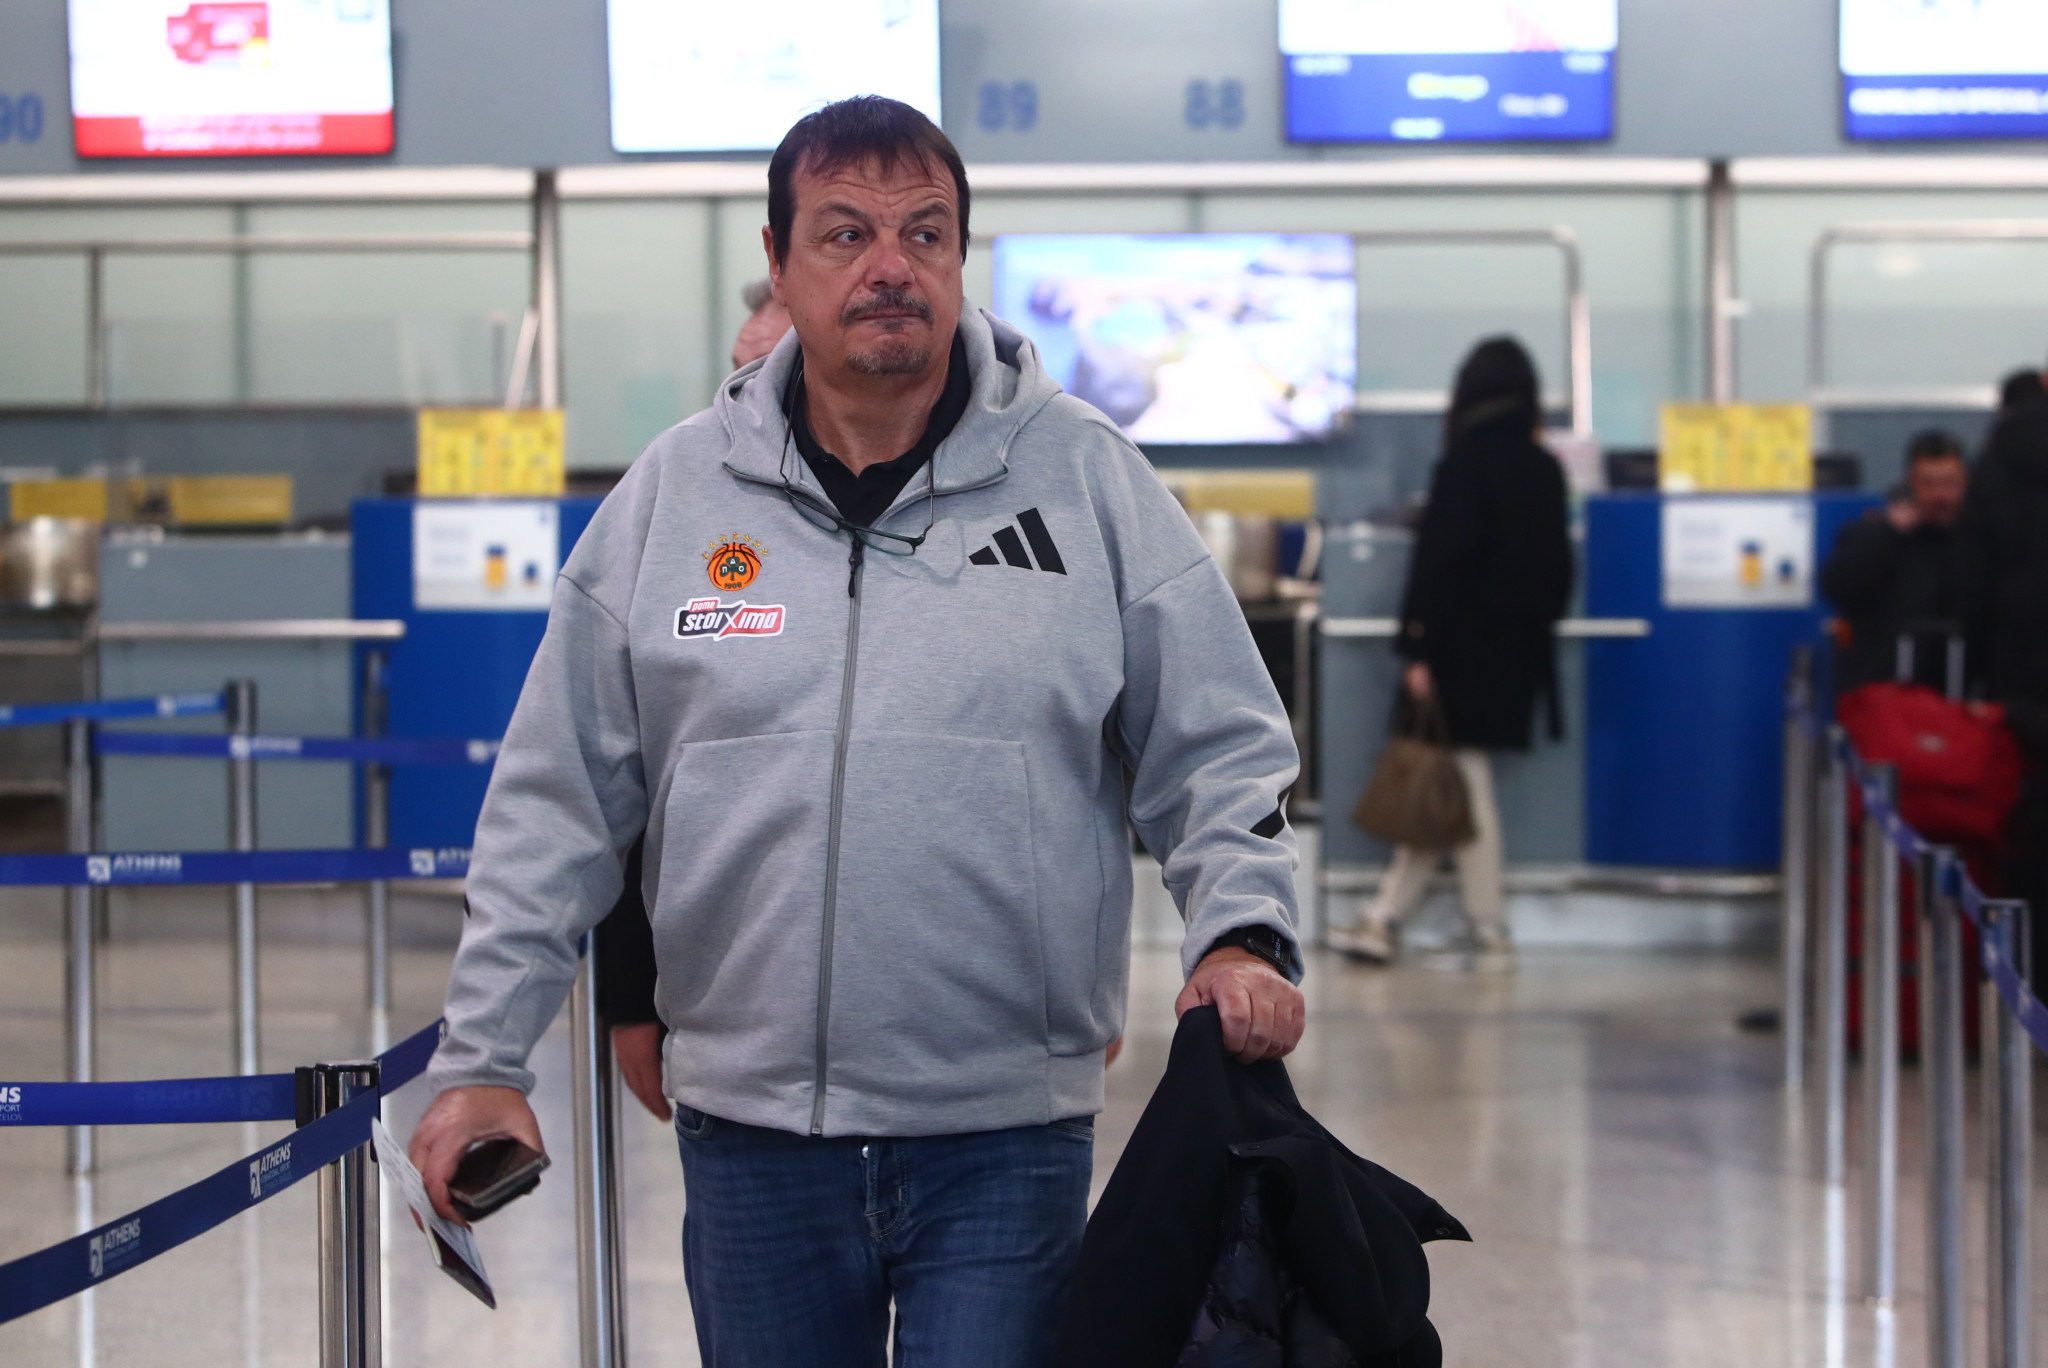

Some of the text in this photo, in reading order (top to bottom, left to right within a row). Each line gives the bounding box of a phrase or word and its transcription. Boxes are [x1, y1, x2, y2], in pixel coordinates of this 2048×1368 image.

[979, 80, 1038, 132] 89
[113, 855, 181, 871] ATHENS
[261, 1142, 291, 1175] ATHENS
[104, 1218, 141, 1251] ATHENS
